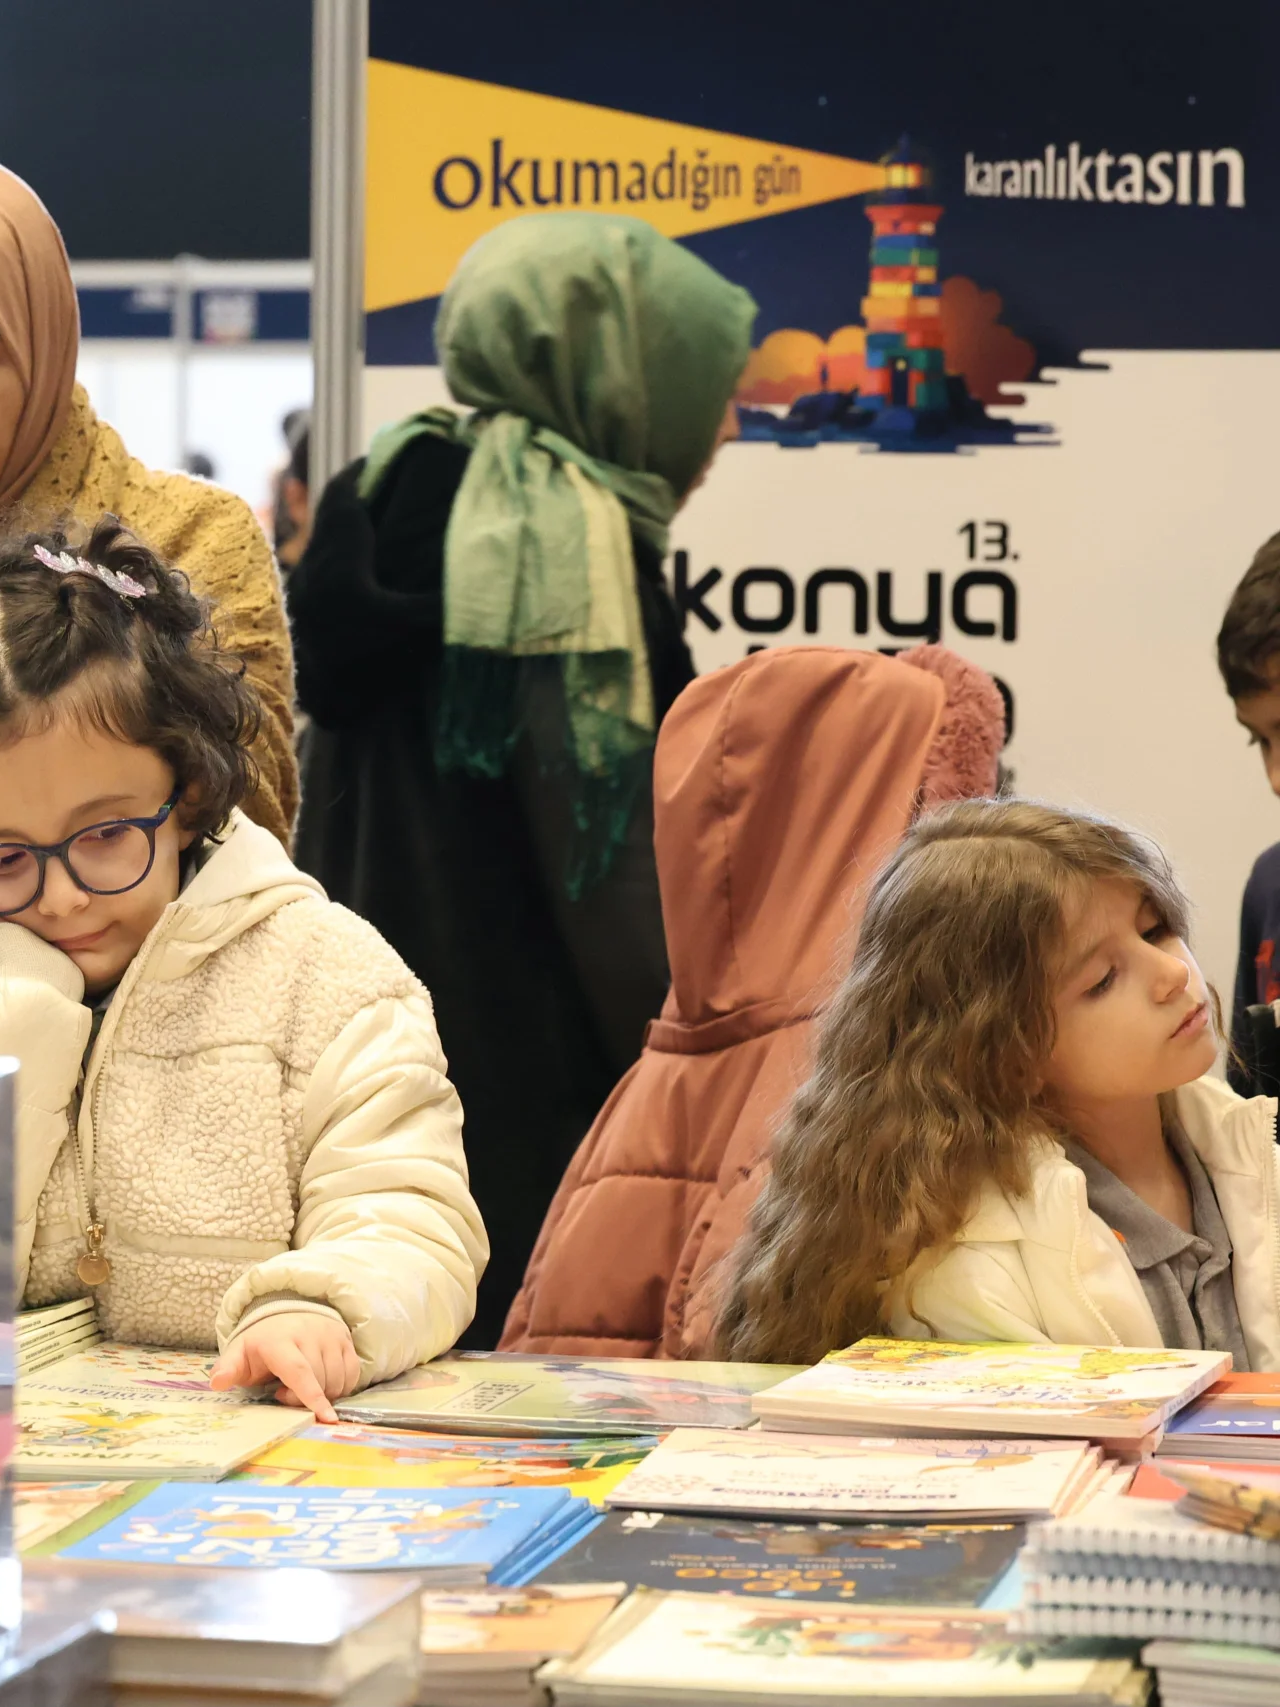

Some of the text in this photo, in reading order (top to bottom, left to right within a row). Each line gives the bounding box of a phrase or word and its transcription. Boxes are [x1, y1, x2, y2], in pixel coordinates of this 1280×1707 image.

[432, 137, 802, 211] okumadığın gün
[965, 141, 1246, 207] karanlıktasın
[957, 519, 1020, 561] 13.
[674, 549, 1017, 645] konya
